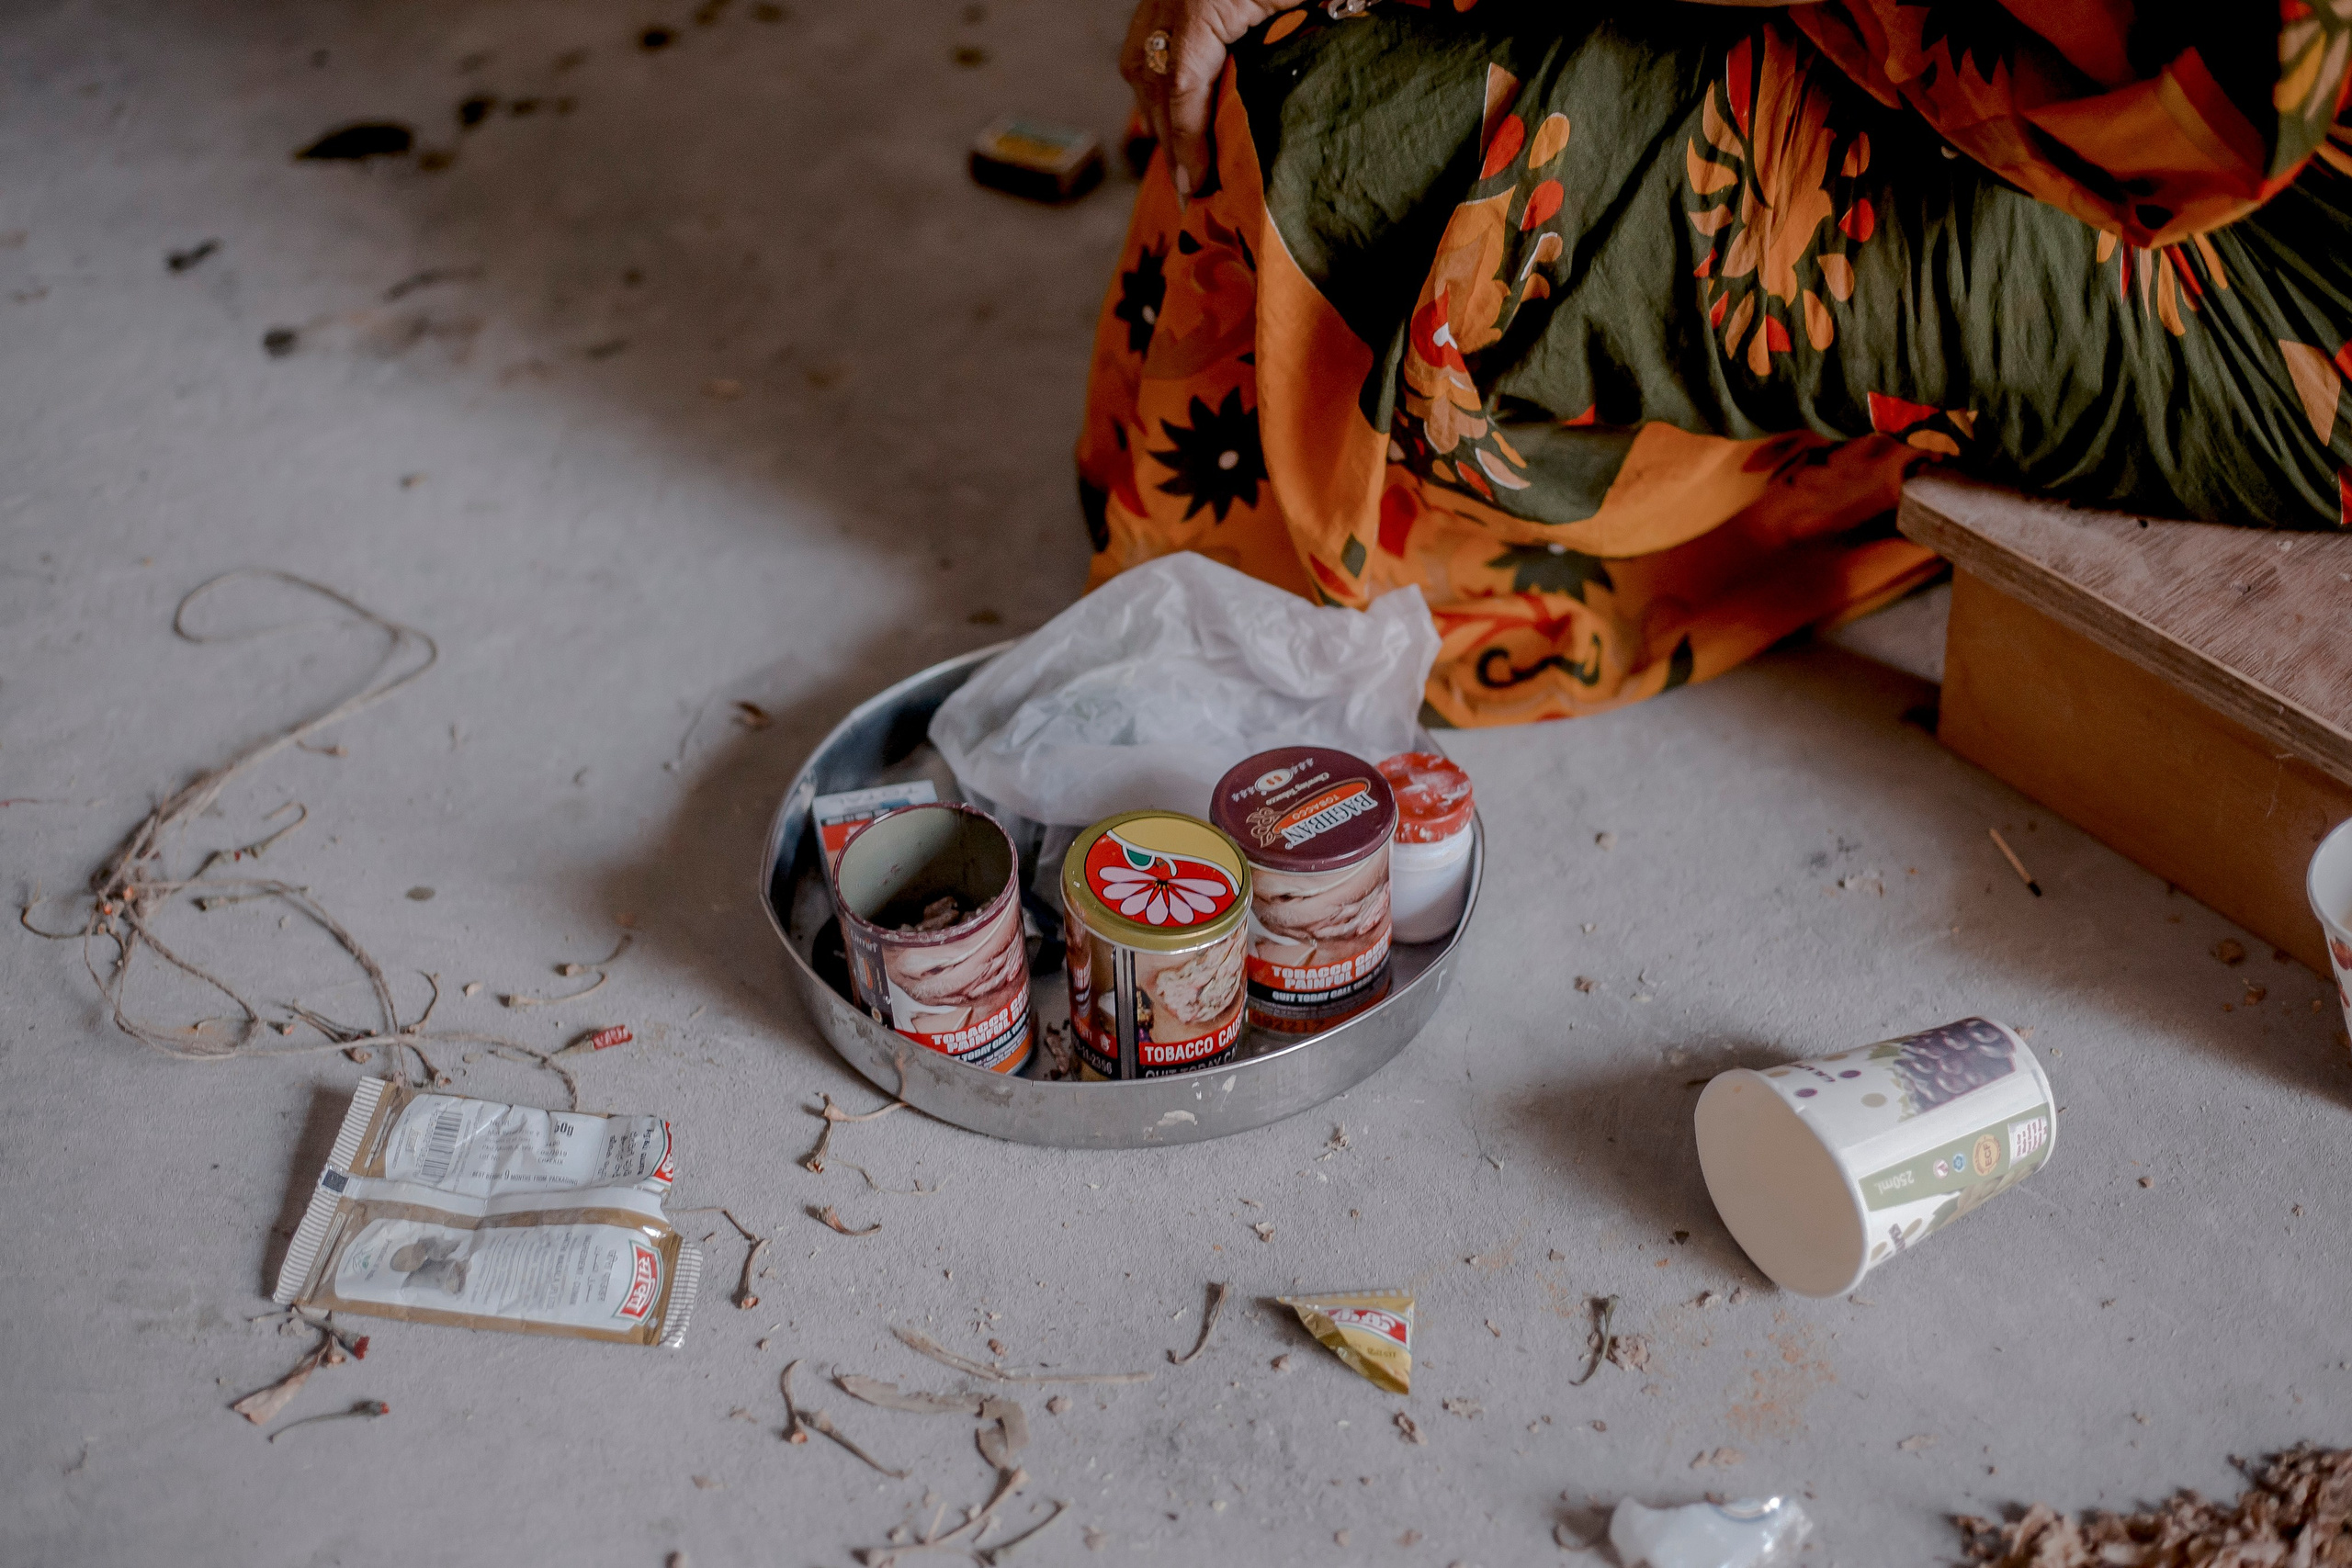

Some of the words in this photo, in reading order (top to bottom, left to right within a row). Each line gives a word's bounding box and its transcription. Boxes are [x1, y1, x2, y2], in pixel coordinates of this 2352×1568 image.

[1293, 794, 1340, 820] TOBACCO
[1281, 793, 1378, 846] BAGHBAN
[1272, 960, 1352, 980] TOBACCO
[1284, 972, 1352, 989] PAINFUL
[1272, 990, 1295, 1002] QUIT
[1296, 991, 1329, 1003] TODAY
[931, 1008, 1009, 1045] TOBACCO
[946, 1018, 1012, 1054] PAINFUL
[960, 1042, 993, 1063] TODAY
[1144, 1036, 1214, 1064] TOBACCO
[1983, 1144, 1993, 1168] ECF
[504, 1168, 510, 1180] 9
[511, 1174, 531, 1182] MONTHS
[548, 1176, 578, 1186] PACKAGING
